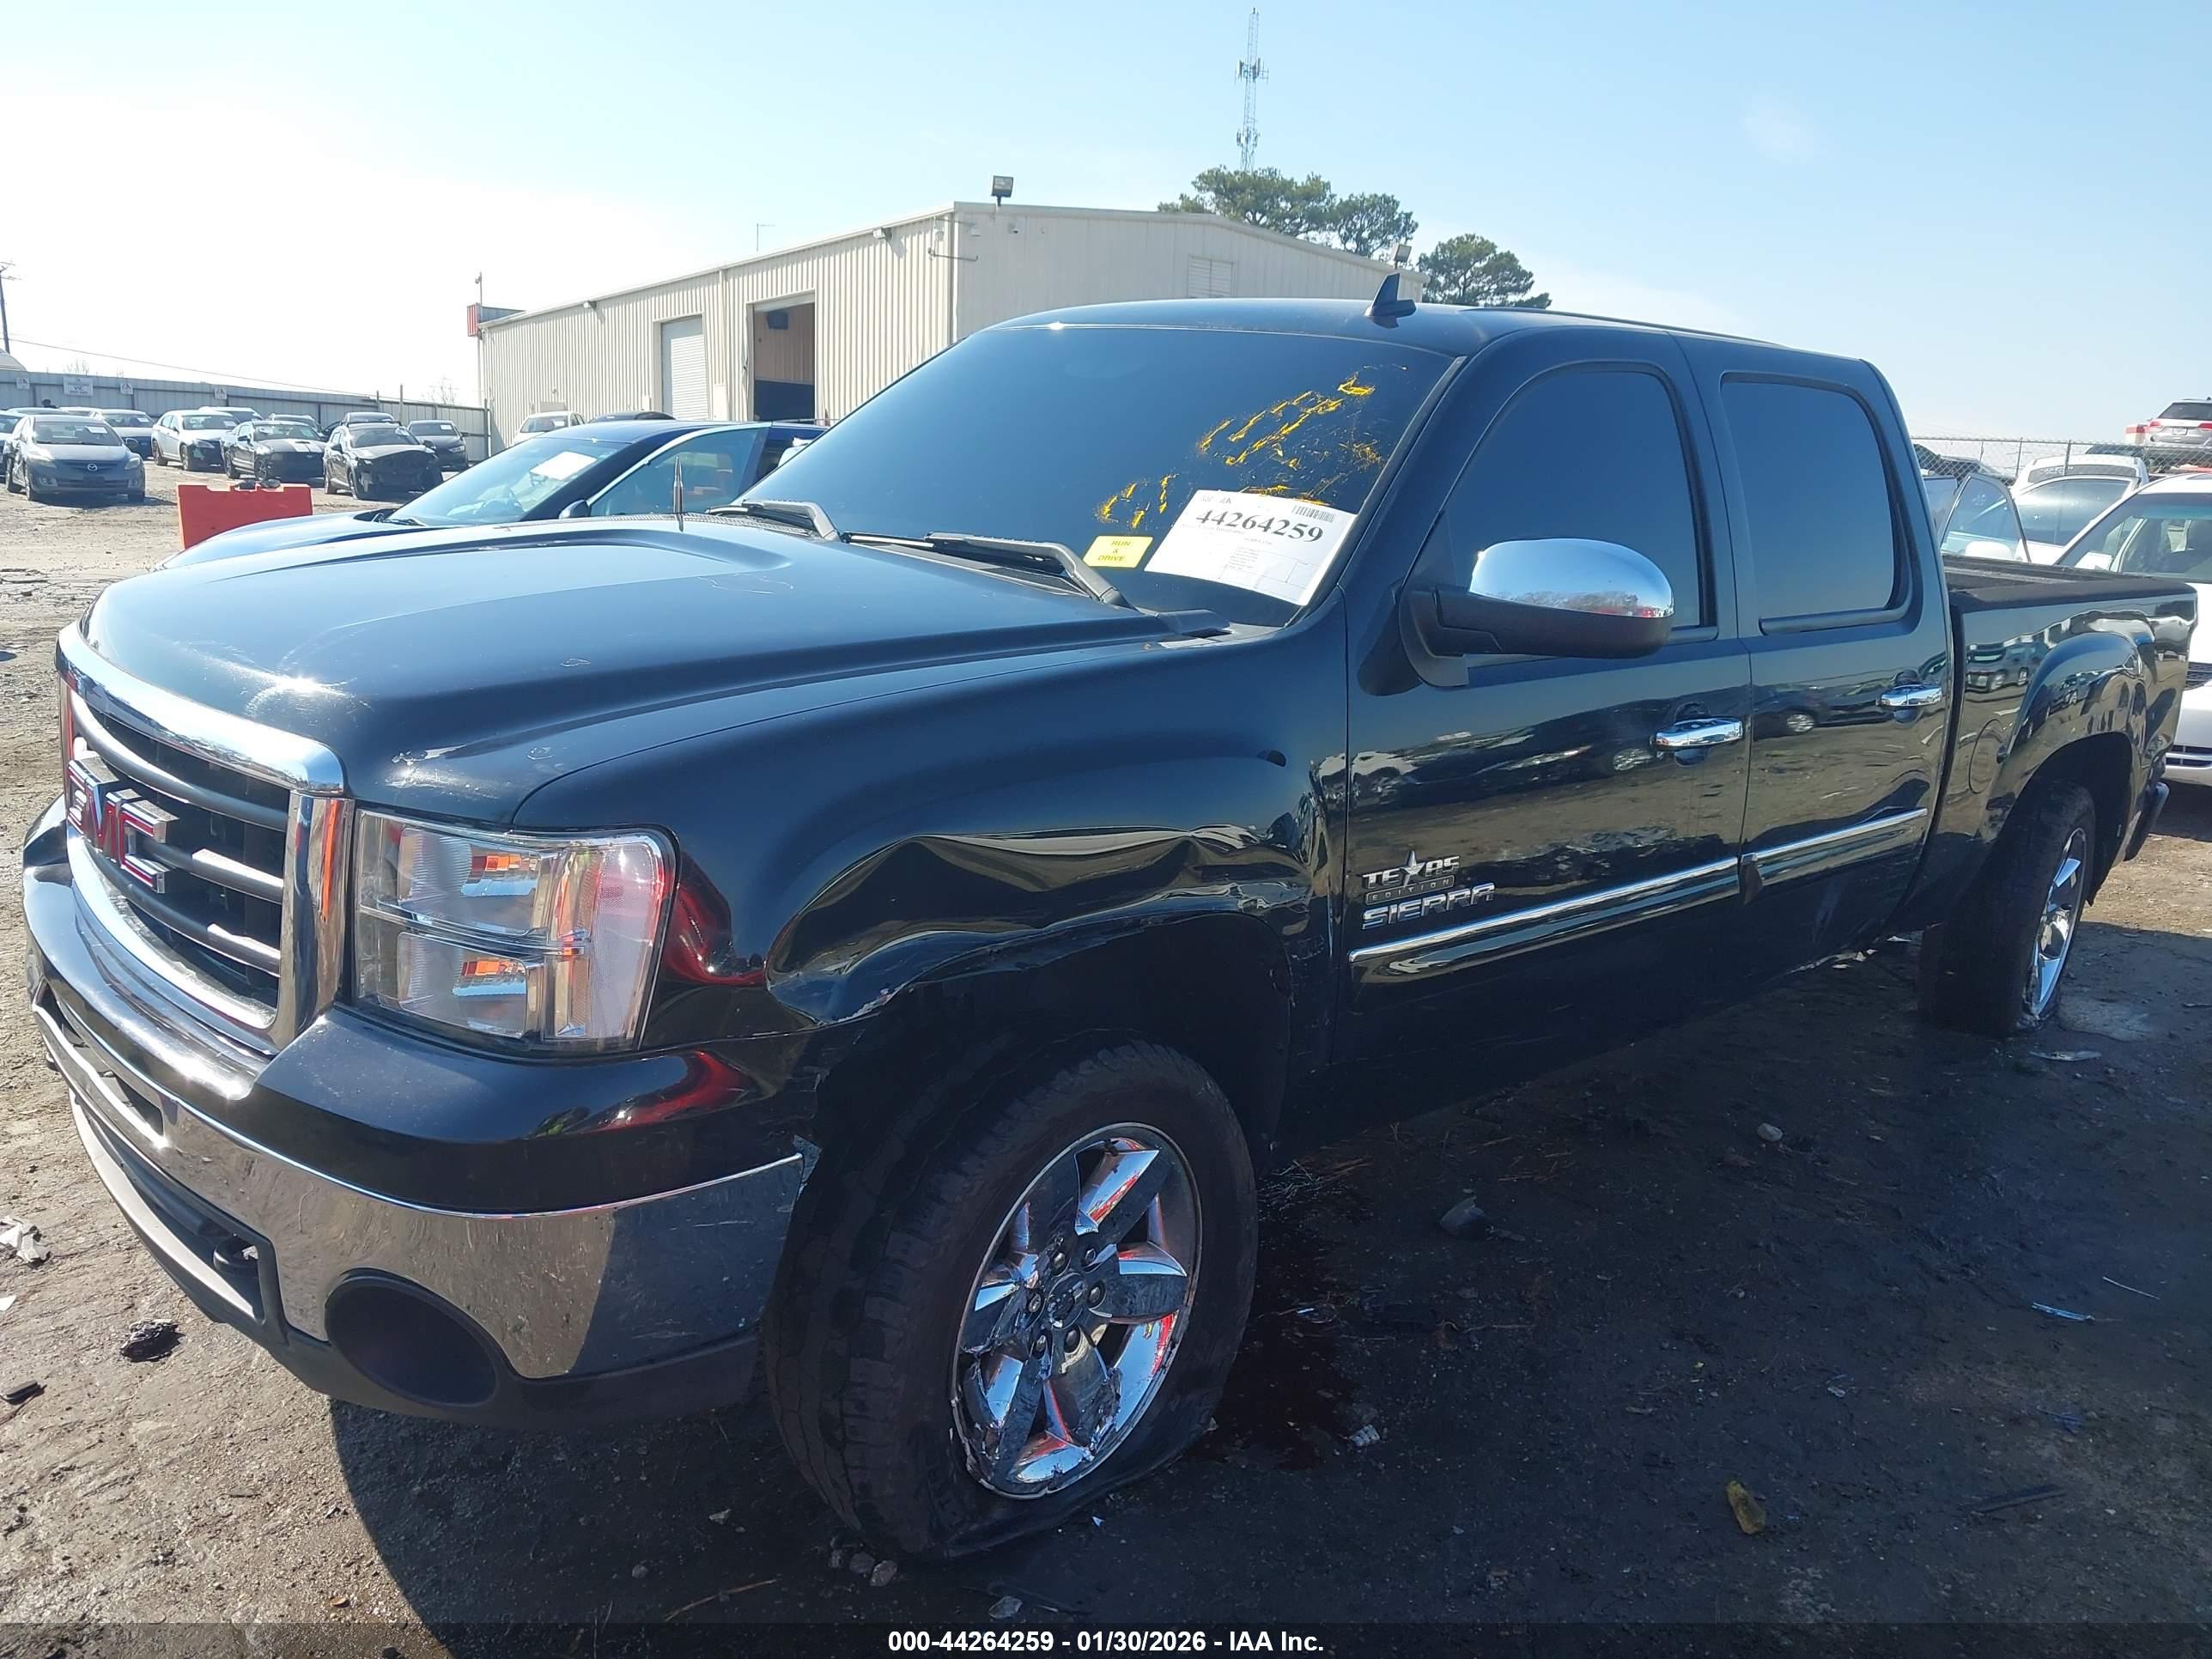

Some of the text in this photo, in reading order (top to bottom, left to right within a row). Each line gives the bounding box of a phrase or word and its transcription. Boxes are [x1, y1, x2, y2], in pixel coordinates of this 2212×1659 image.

[1195, 509, 1324, 543] 44264259
[1362, 850, 1460, 890] TEXAS
[1362, 882, 1496, 930] SIERRA
[1371, 878, 1451, 902] EDITION
